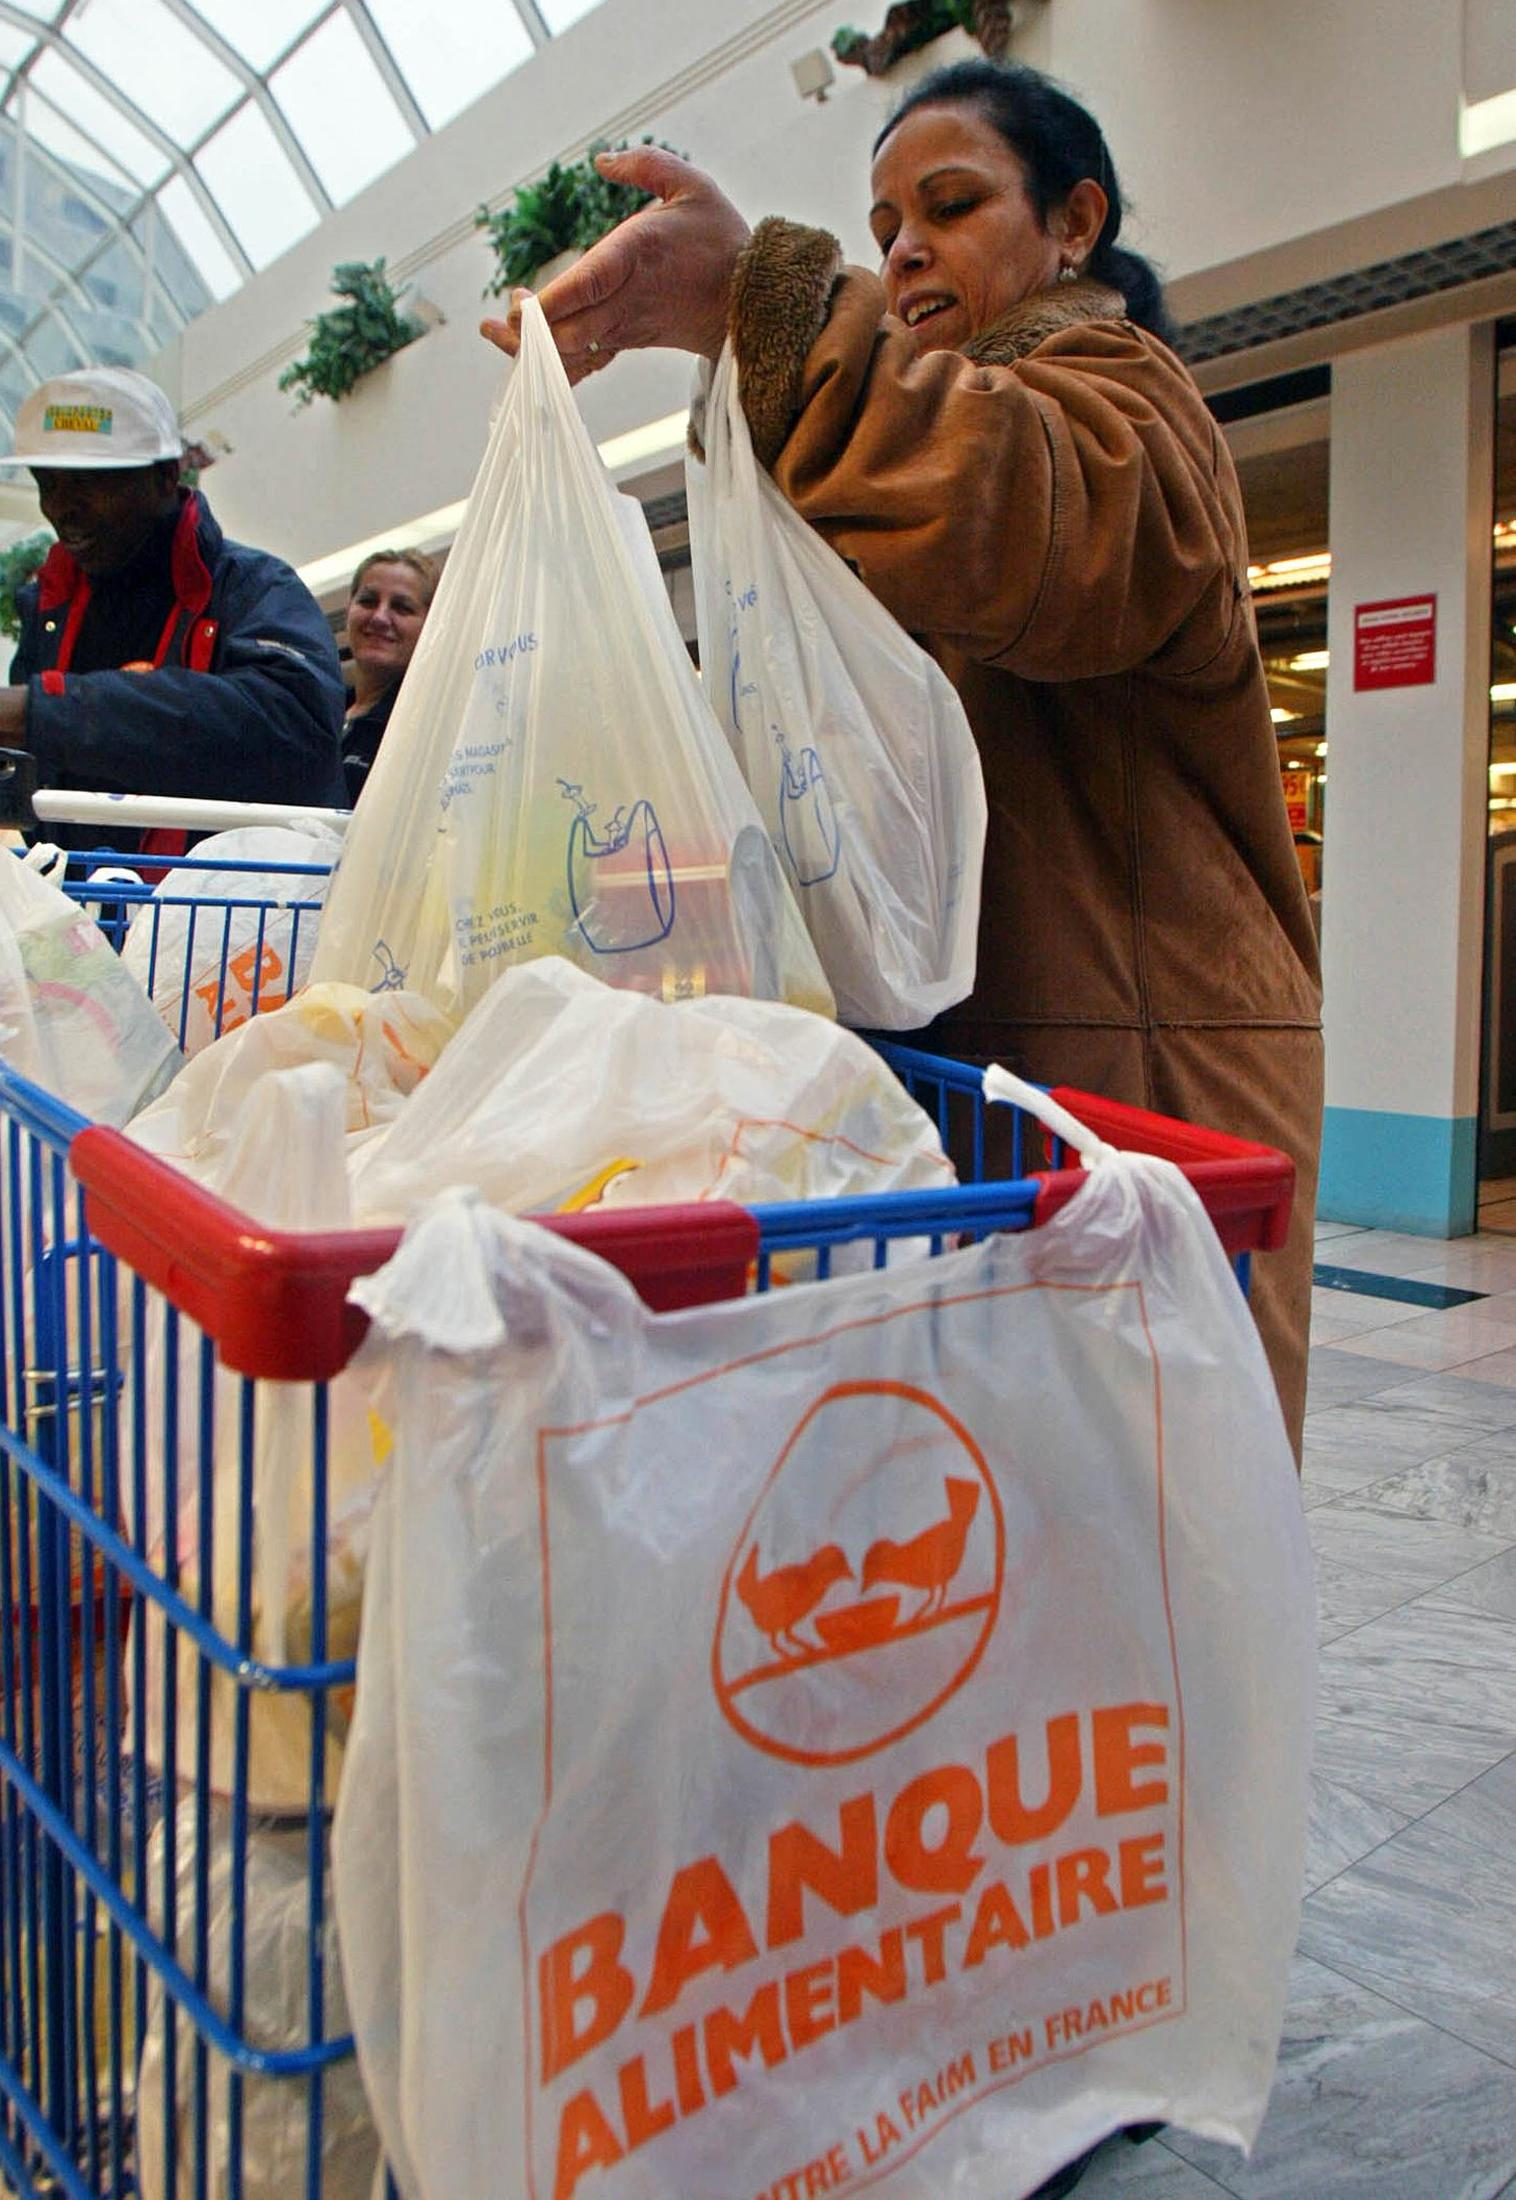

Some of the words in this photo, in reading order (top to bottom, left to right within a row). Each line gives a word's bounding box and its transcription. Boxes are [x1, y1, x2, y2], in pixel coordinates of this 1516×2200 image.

[540, 1704, 1169, 2083] BANQUE
[552, 1833, 1168, 2200] ALIMENTAIRE
[856, 2111, 903, 2167] LA
[899, 2050, 976, 2130] FAIM
[986, 2027, 1033, 2075] EN
[1044, 1976, 1172, 2050] FRANCE
